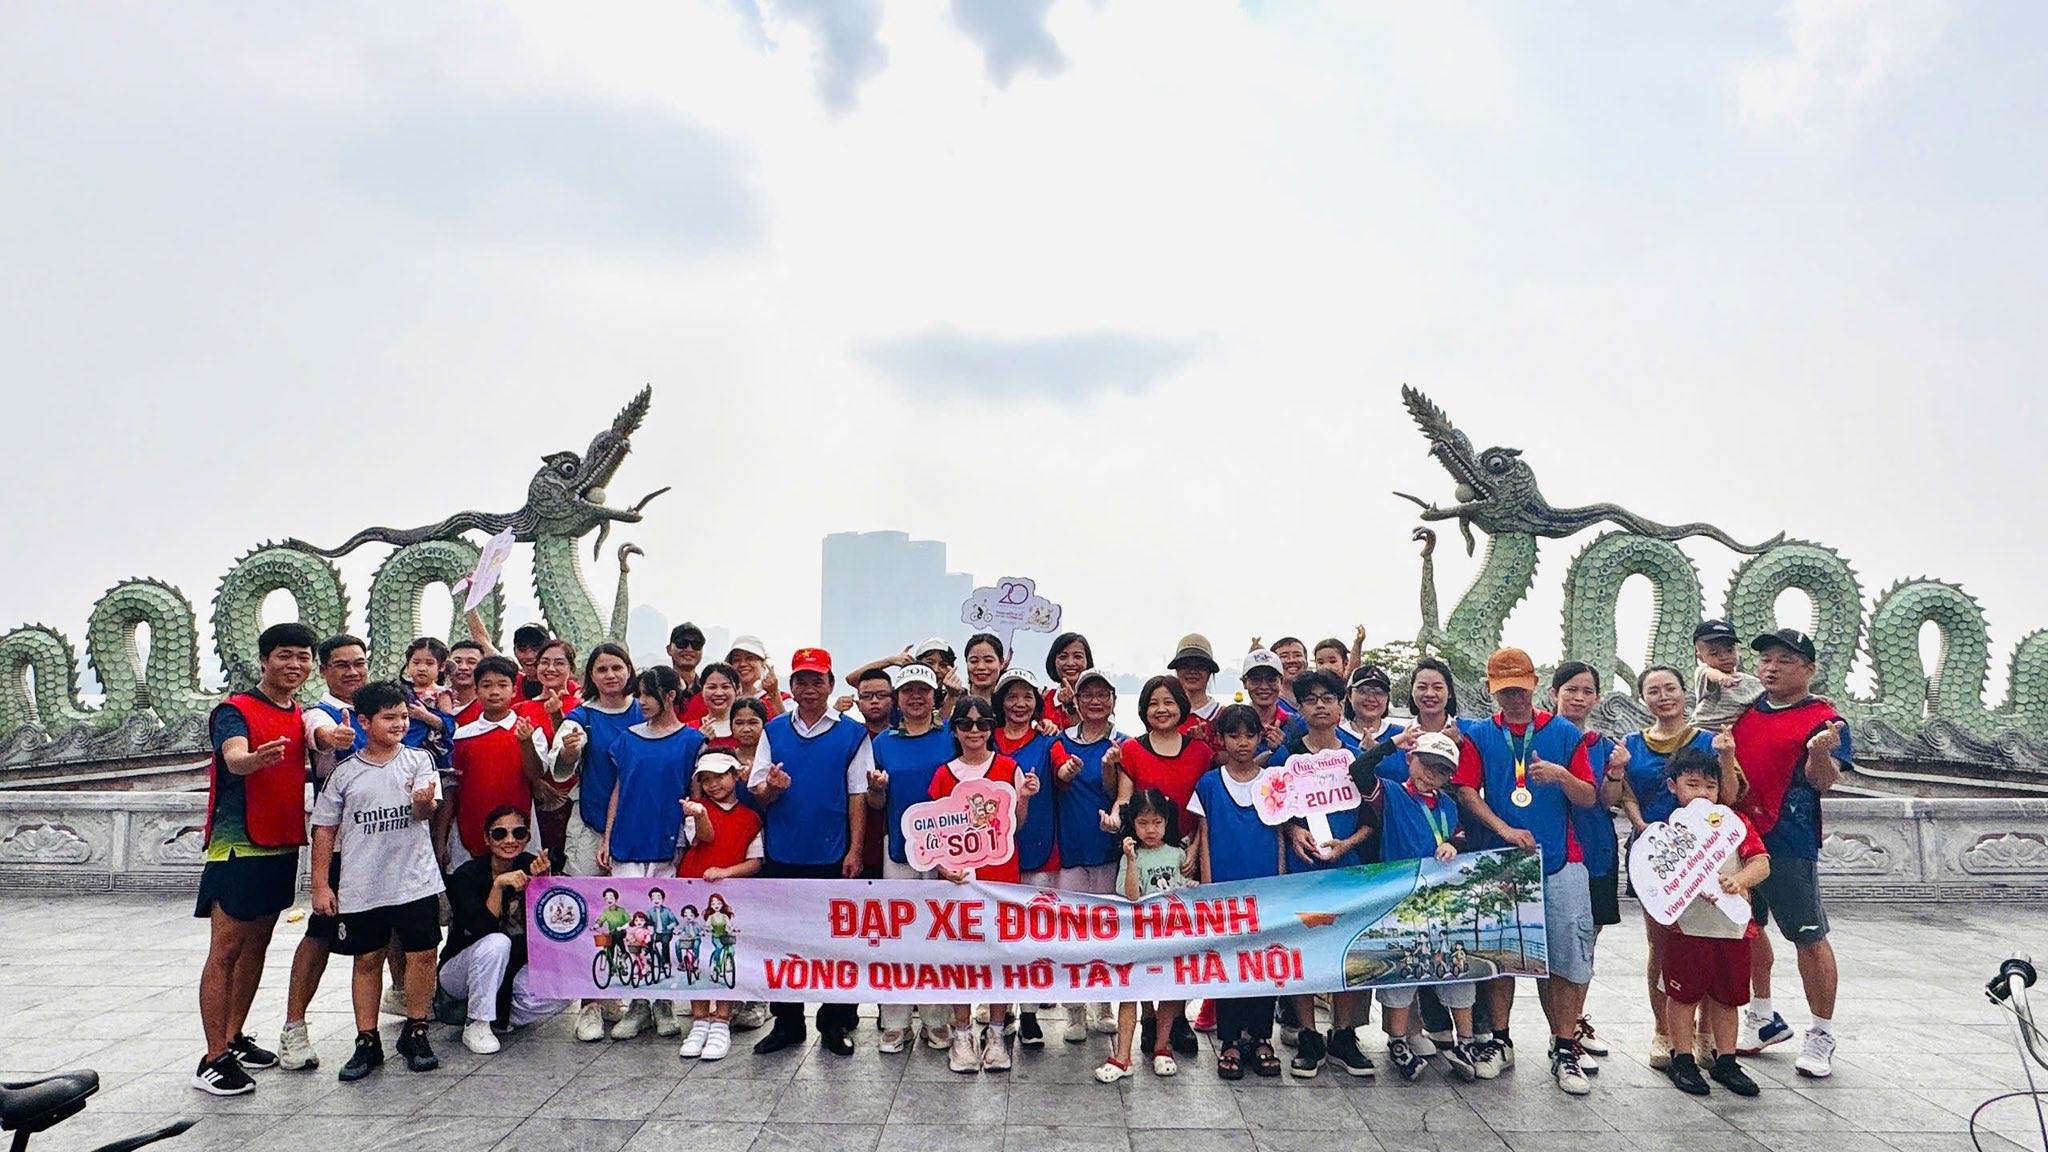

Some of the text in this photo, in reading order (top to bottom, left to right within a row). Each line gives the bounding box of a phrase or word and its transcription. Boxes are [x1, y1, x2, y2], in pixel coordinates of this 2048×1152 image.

[998, 582, 1029, 605] 20
[1305, 786, 1353, 808] 20/10
[354, 804, 412, 824] Emirate
[378, 817, 409, 832] BETTER
[914, 819, 935, 831] GIA
[926, 824, 996, 857] là SỐ 1
[1147, 865, 1175, 877] Mickey
[1684, 872, 1706, 898] quanh
[1727, 829, 1741, 846] HN
[1663, 878, 1681, 896] Đạp
[1679, 869, 1688, 880] xe
[829, 892, 1260, 947] ĐẠP XE ĐỒNG HÀNH
[764, 953, 859, 990] VÒNG
[867, 962, 993, 991] QUANH
[1003, 957, 1056, 990] HỒ
[1061, 958, 1135, 988] TÂY
[1173, 950, 1229, 985] HÀ
[1237, 943, 1305, 988] NỘI
